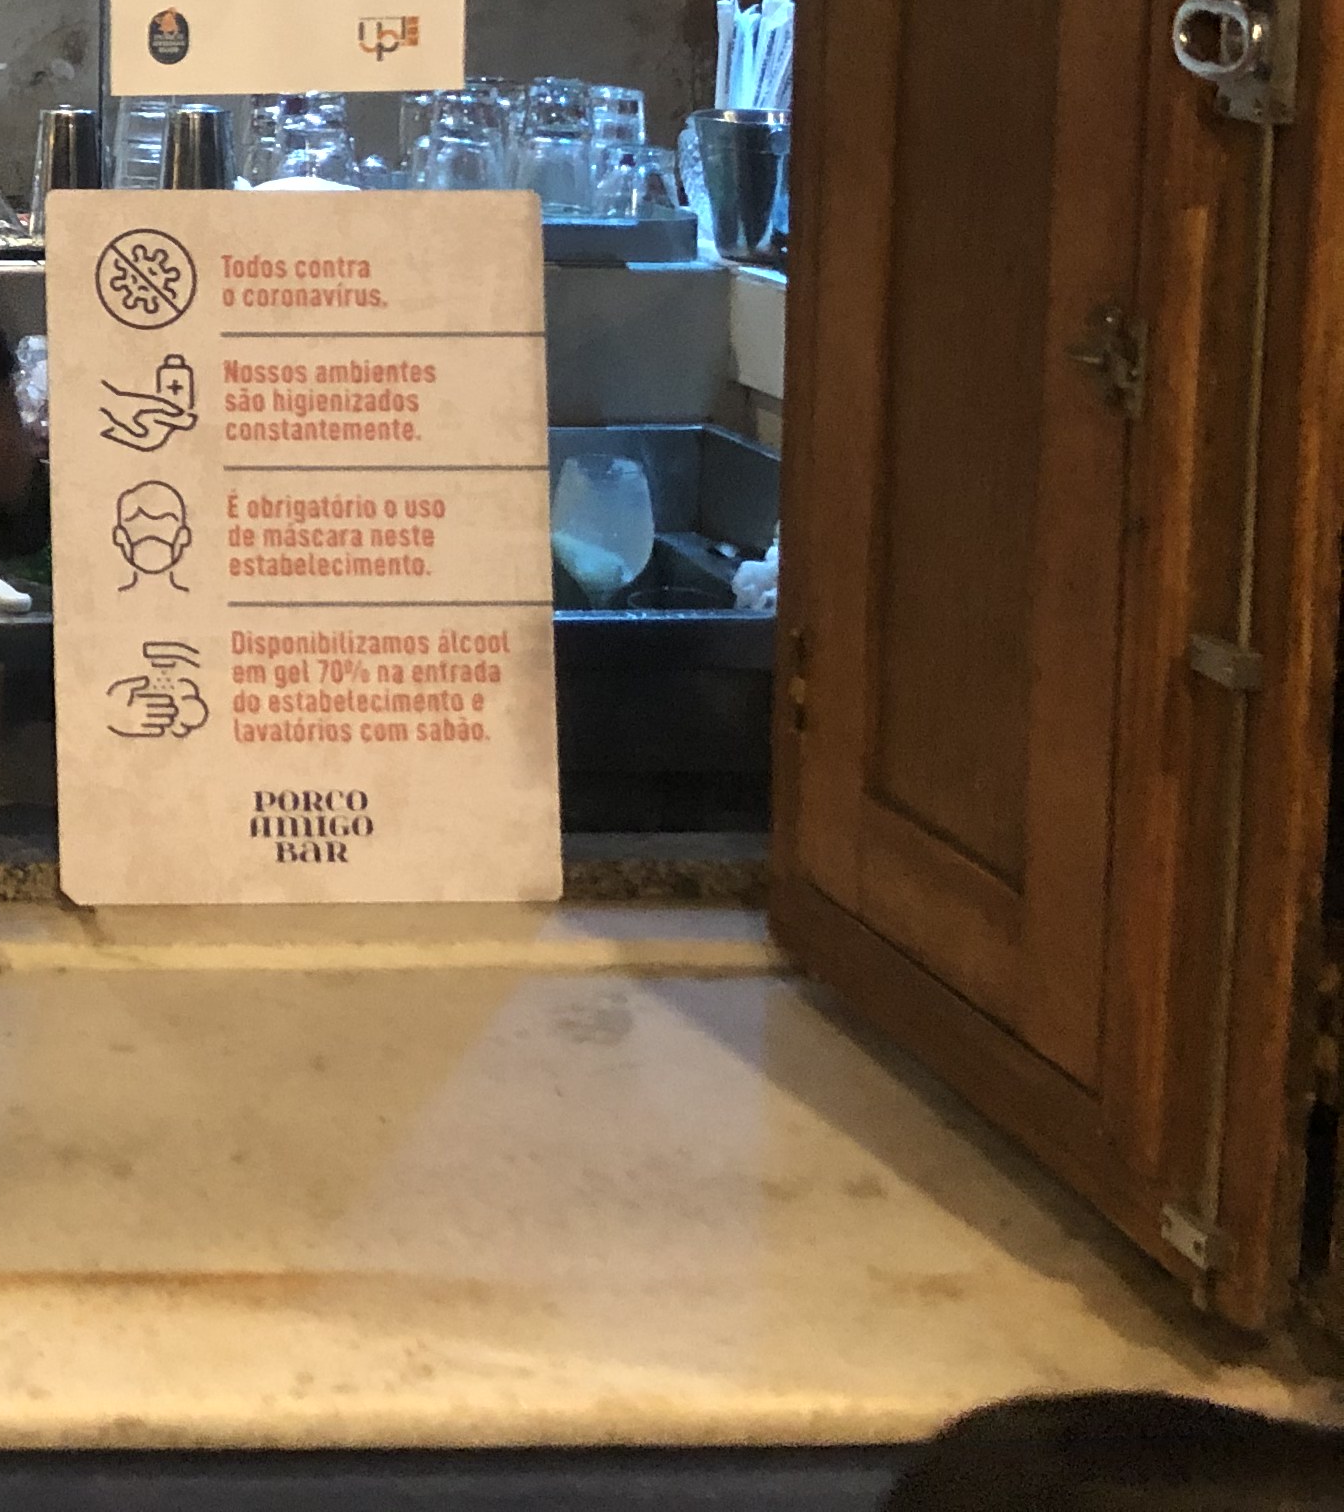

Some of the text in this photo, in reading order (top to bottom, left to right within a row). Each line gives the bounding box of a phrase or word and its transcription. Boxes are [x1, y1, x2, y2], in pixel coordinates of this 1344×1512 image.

[221, 254, 371, 279] Todos contra
[222, 282, 388, 307] o coronavírus.
[223, 359, 437, 383] Nossos ambientes
[224, 388, 420, 417] são higienizados
[225, 418, 422, 441] constantemente.
[226, 489, 446, 523] É obrigatório o uso
[228, 521, 435, 548] de máscara neste
[229, 552, 432, 576] estabelecimento.
[231, 629, 511, 659] Disponibilizamos álcool
[232, 659, 502, 688] em gel 70% na entrada
[233, 689, 485, 713] do estabelecimento e
[233, 716, 491, 743] lavatórios com sabão.
[253, 788, 369, 812] PORCO
[275, 840, 349, 864] BAR
